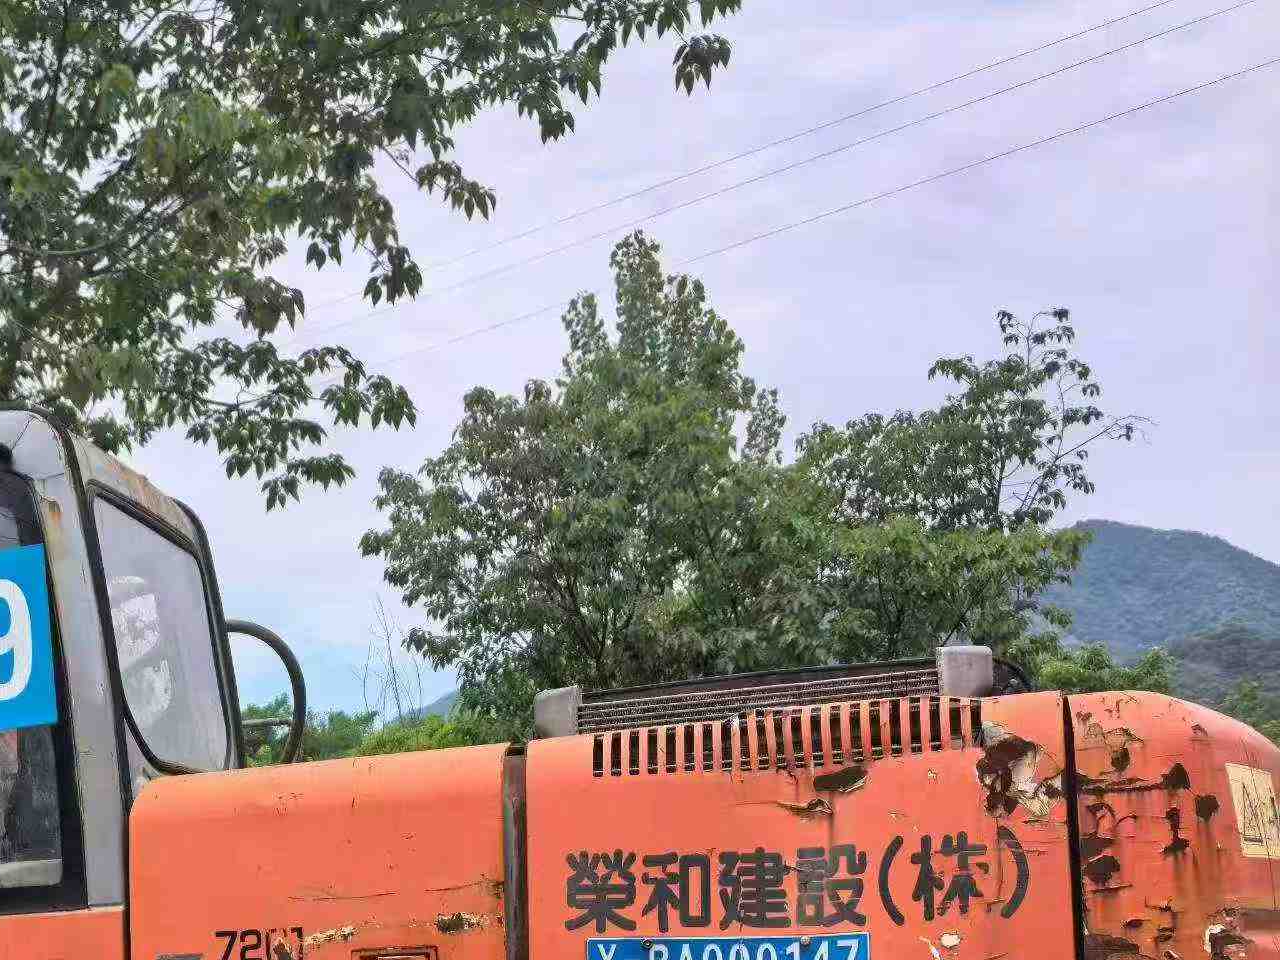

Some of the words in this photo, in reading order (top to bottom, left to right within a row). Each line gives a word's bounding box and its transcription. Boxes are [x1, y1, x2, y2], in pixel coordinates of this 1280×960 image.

[563, 825, 1031, 933] 榮和建設(株)
